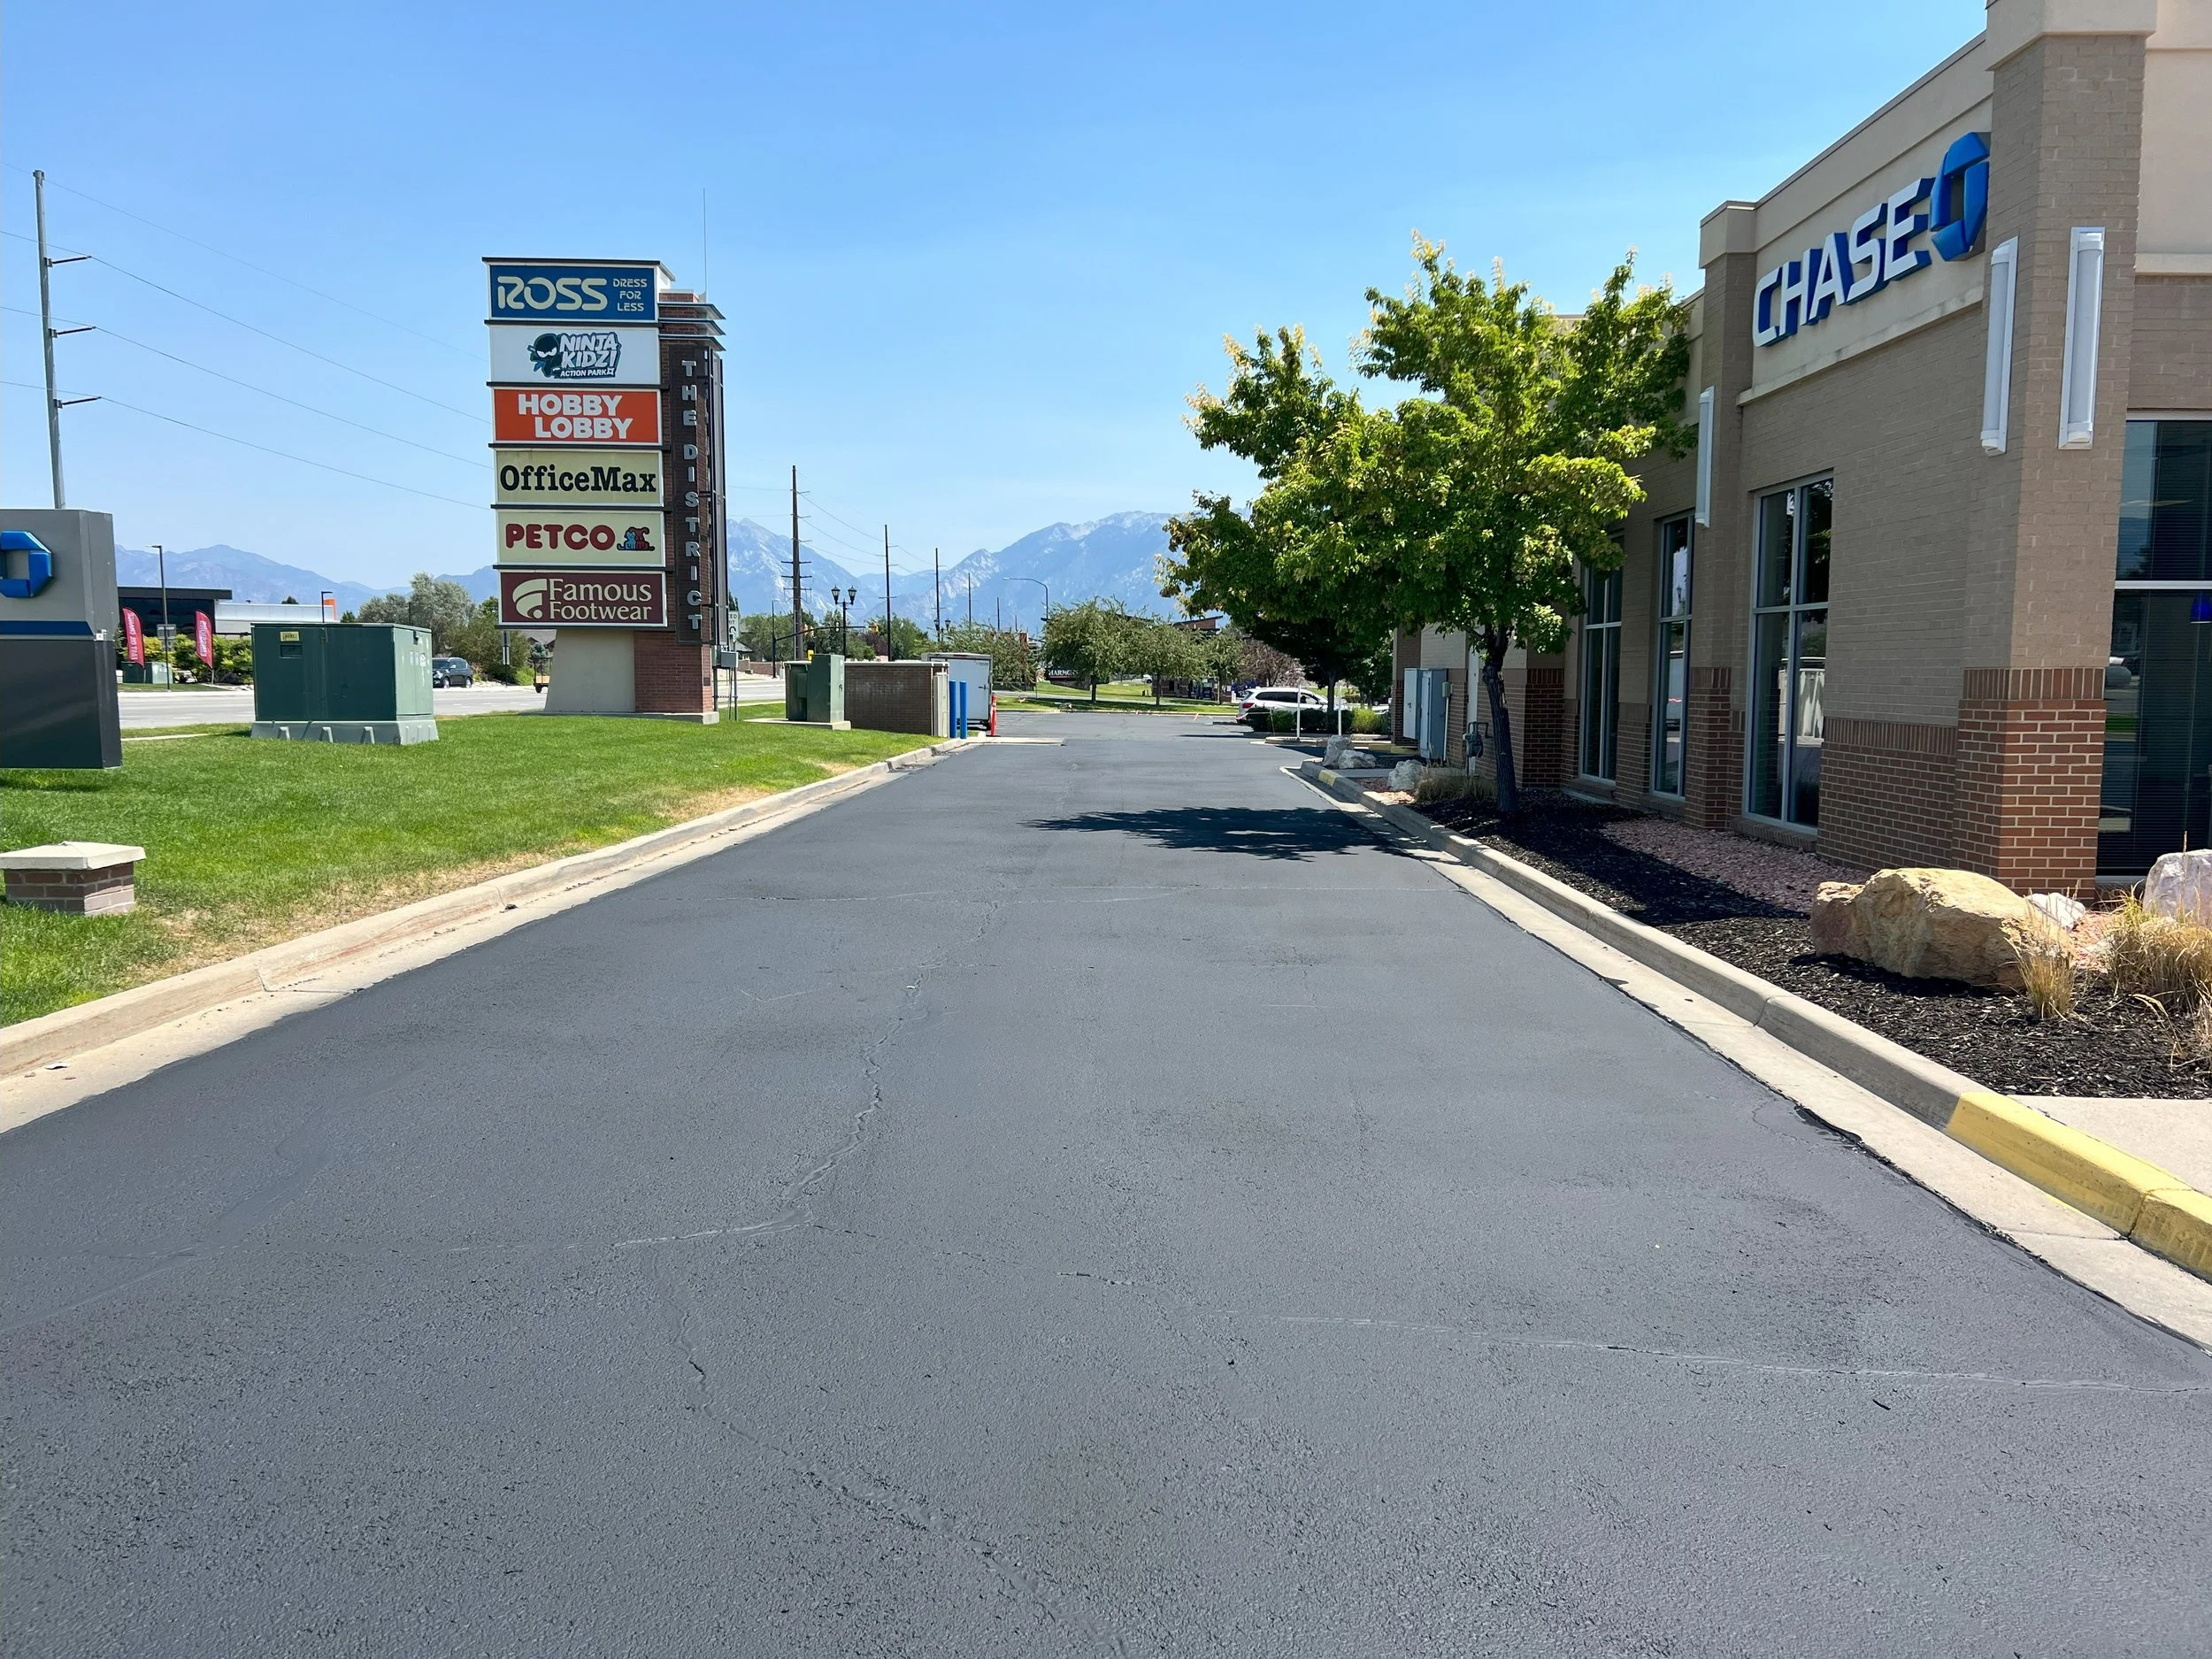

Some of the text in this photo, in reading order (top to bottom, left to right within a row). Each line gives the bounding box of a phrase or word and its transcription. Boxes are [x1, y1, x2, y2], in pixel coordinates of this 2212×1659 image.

[1753, 178, 1934, 347] CHASE
[497, 276, 608, 311] ROSS
[613, 279, 648, 288] DRESS
[619, 291, 641, 300] FOR
[617, 303, 644, 311] LESS
[560, 334, 618, 352] NINJA
[518, 394, 622, 416] HOBBY
[534, 417, 634, 439] LOBBY
[500, 465, 657, 492] OfficeMax
[681, 360, 702, 630] THE DISTRICT
[505, 524, 616, 550] PETCO
[549, 579, 652, 602] Famous
[549, 601, 651, 620] Footwear
